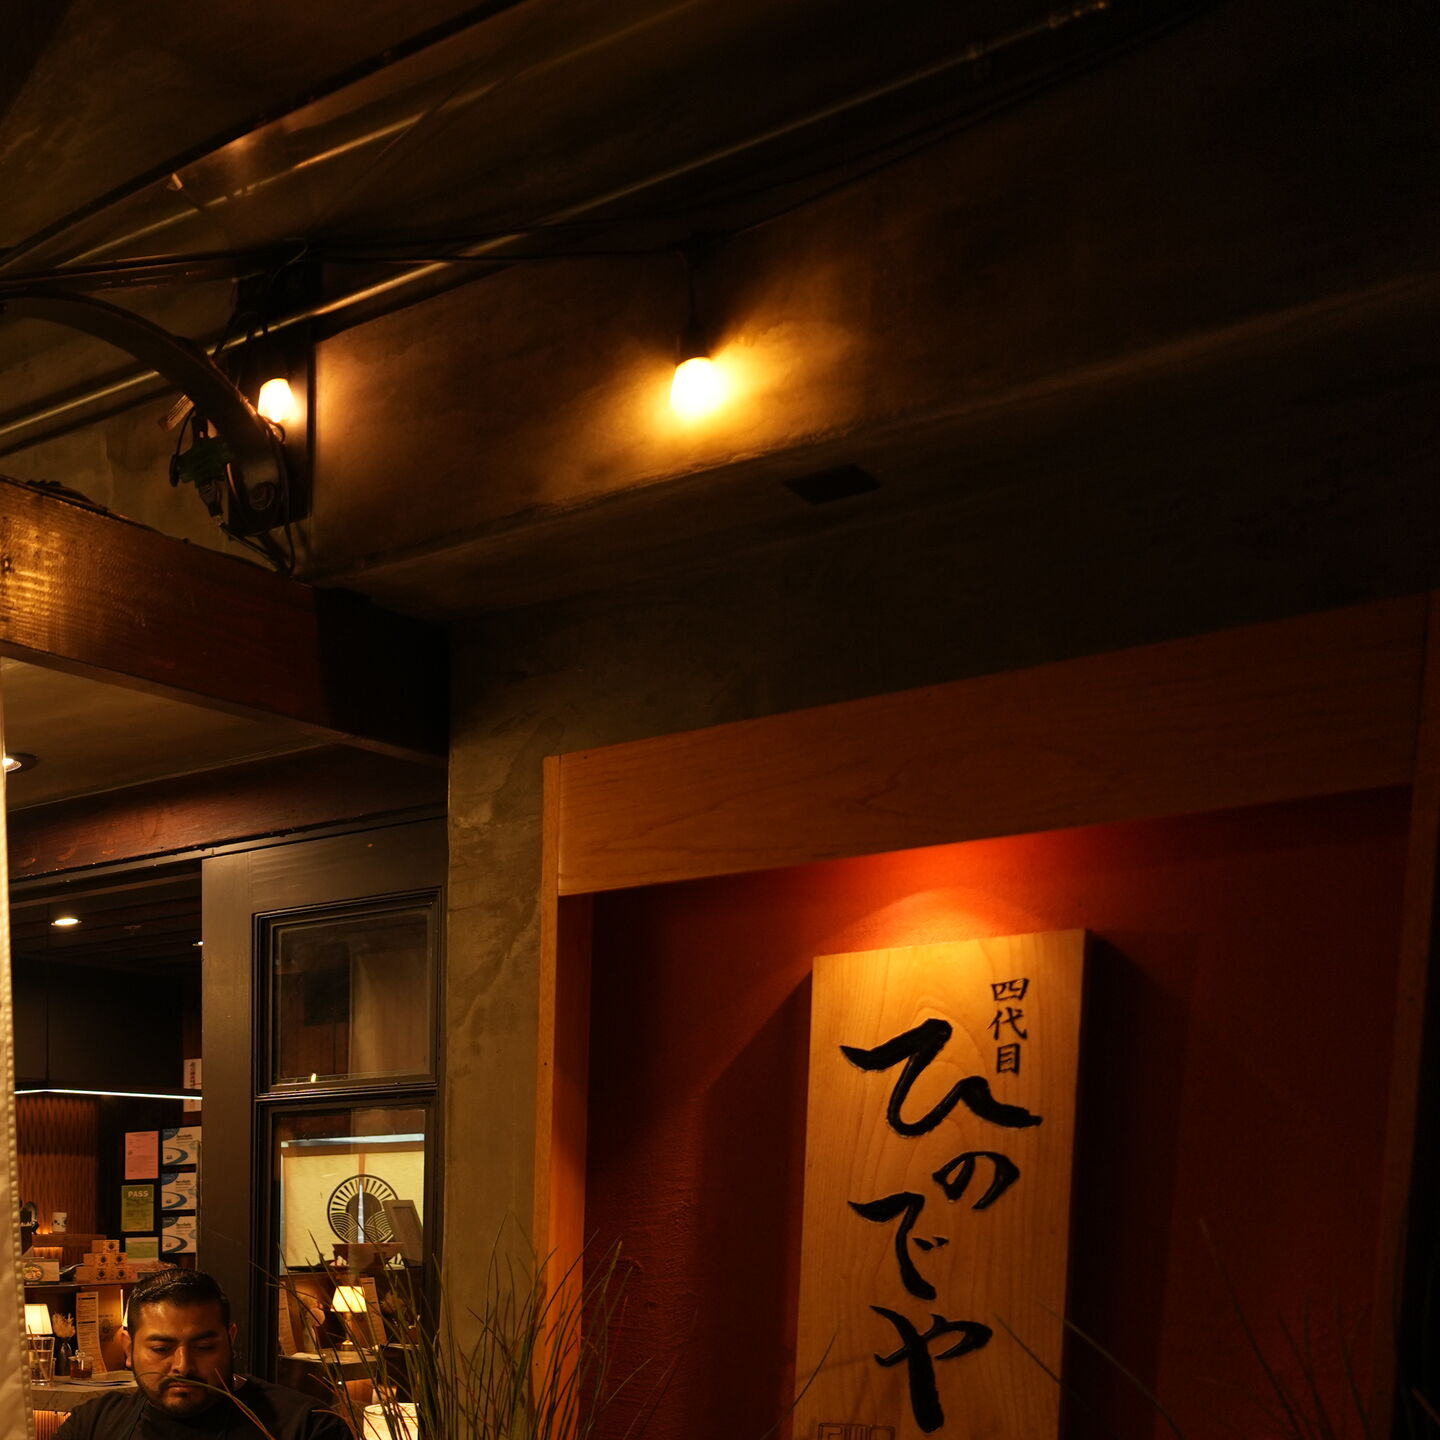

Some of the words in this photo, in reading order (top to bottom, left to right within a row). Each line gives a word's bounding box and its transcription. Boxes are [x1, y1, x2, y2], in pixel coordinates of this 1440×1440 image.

[988, 977, 1029, 1075] 四代目
[127, 1190, 149, 1198] PASS
[839, 1018, 1043, 1435] ひのでや
